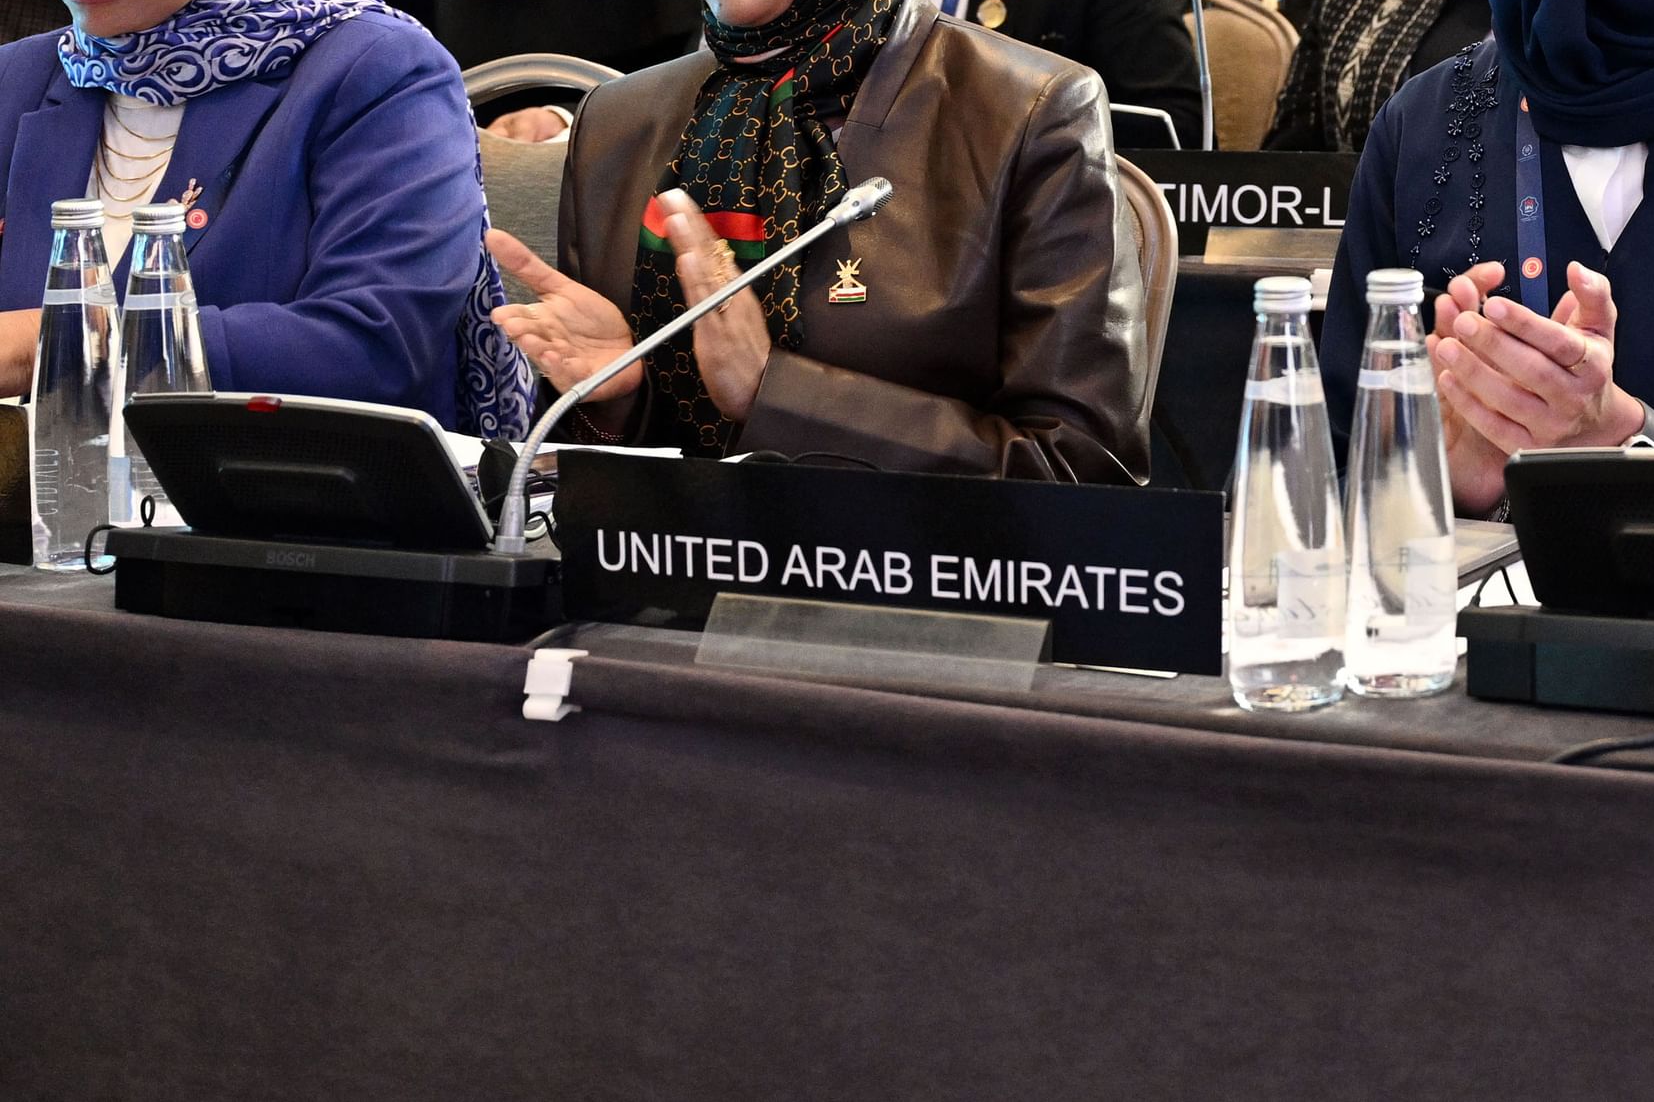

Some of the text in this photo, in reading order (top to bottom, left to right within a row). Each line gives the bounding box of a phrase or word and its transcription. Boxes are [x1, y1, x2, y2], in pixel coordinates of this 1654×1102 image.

[265, 549, 316, 567] BOSCH
[597, 529, 769, 583] UNITED
[781, 544, 914, 595] ARAB
[931, 554, 1185, 616] EMIRATES
